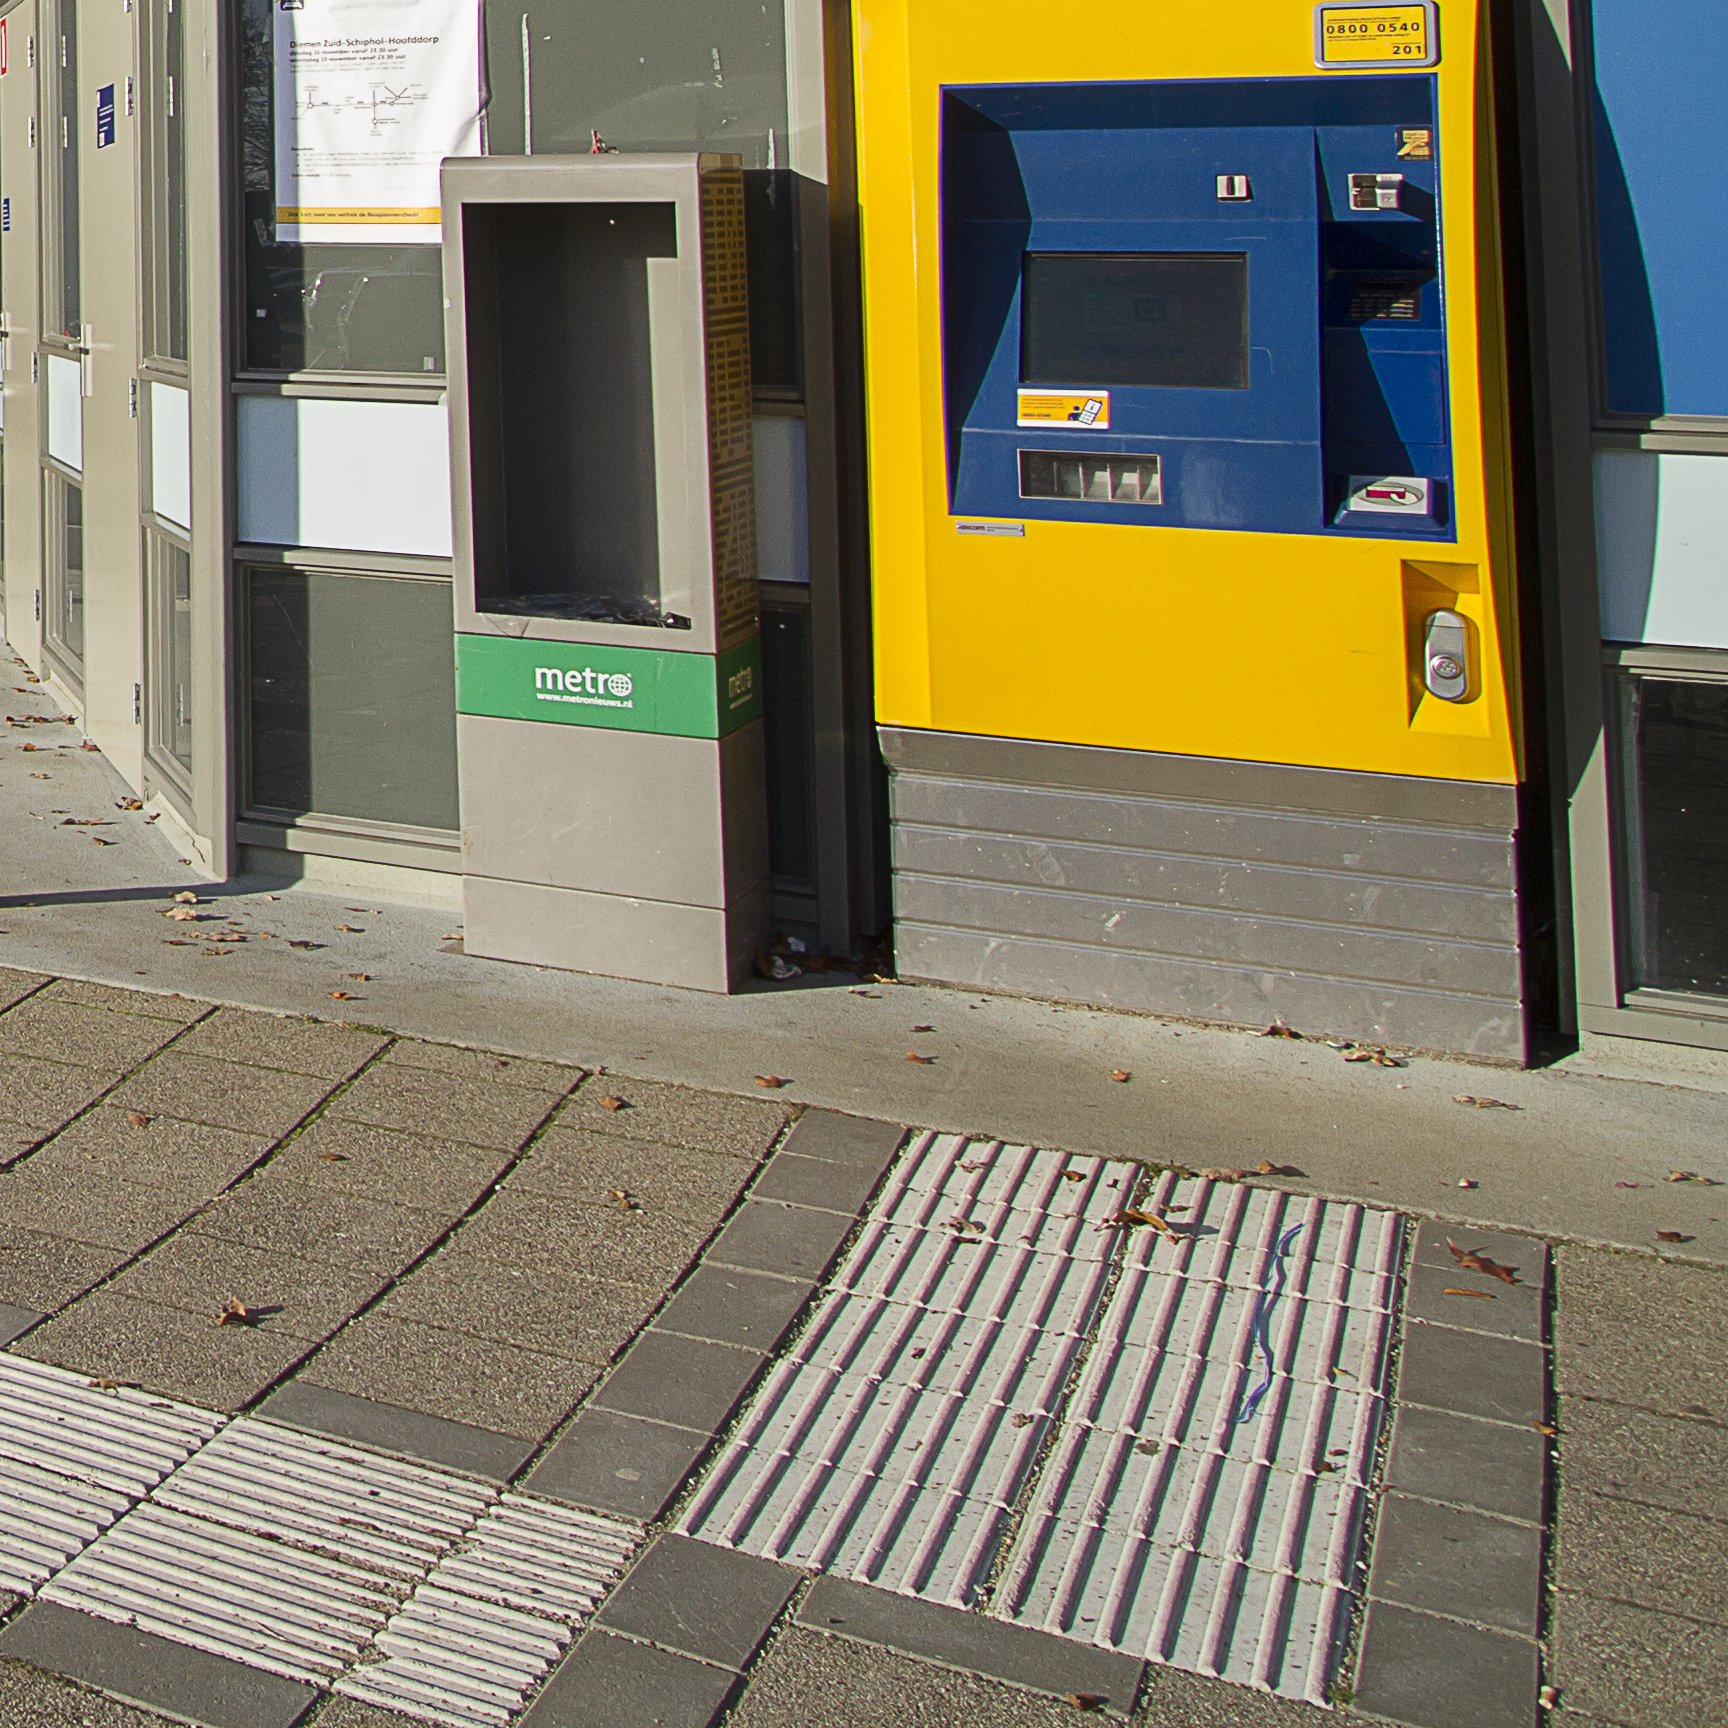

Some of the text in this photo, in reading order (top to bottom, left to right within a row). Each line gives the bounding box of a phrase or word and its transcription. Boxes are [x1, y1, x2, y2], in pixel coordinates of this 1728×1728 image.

[1326, 22, 1420, 34] 0800 0540
[1392, 45, 1422, 55] 201
[535, 666, 633, 697] metro
